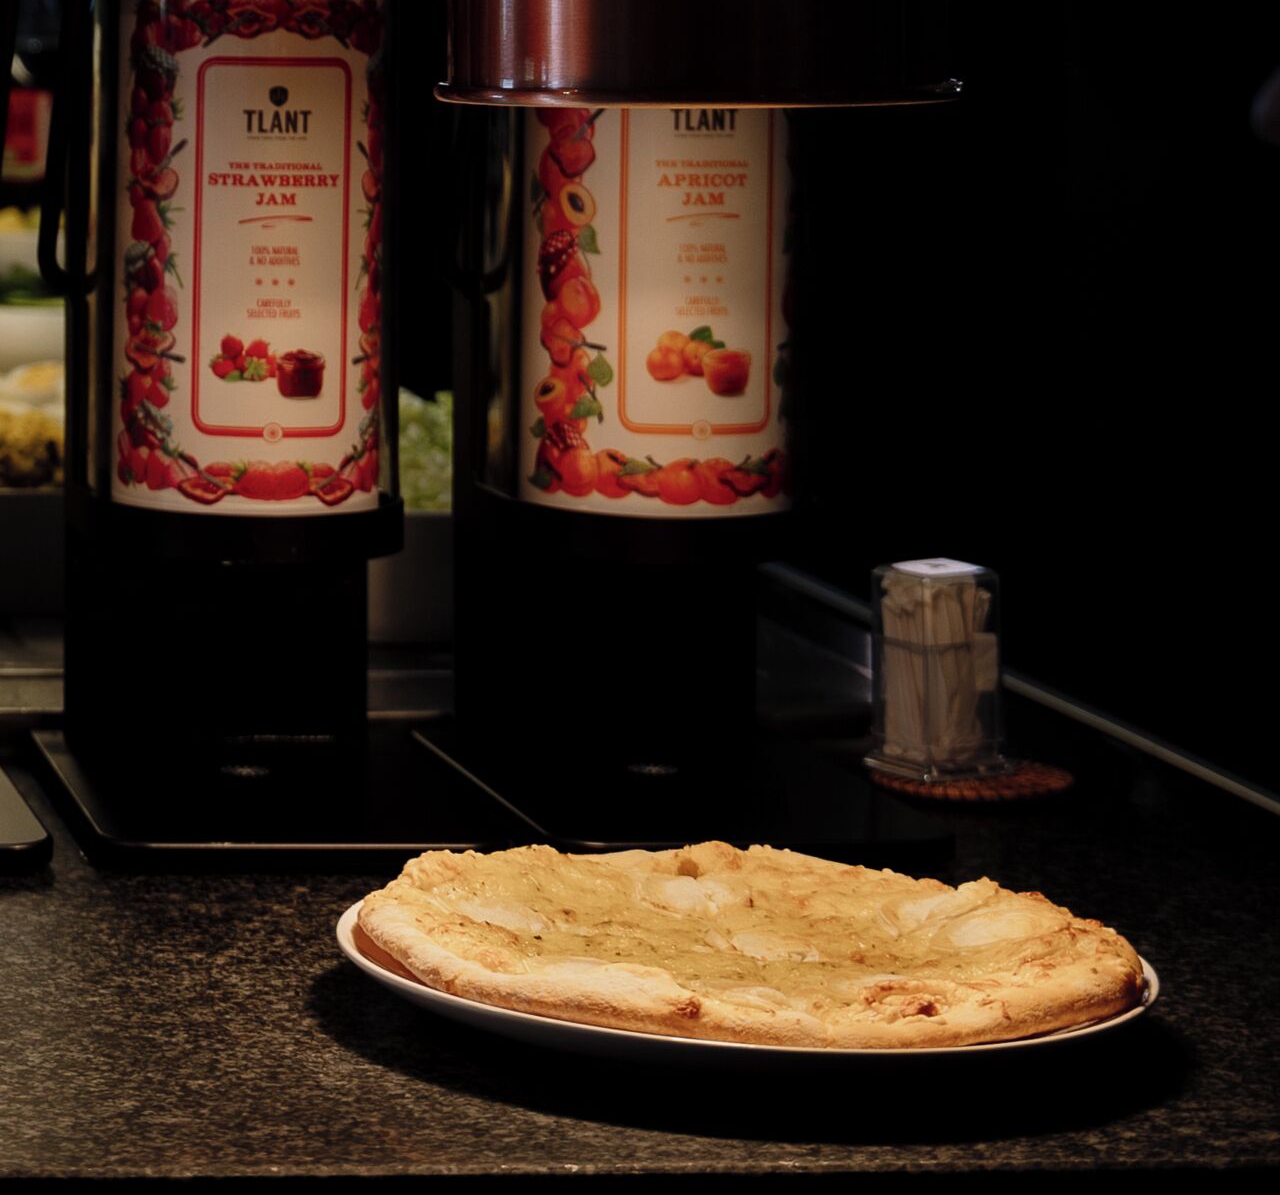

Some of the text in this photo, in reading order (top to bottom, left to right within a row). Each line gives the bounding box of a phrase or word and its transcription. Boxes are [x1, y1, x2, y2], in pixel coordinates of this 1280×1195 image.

[243, 110, 312, 133] TLANT
[671, 108, 739, 131] TLANT
[228, 161, 323, 171] THE TRADITIONAL
[208, 172, 339, 188] STRAWBERRY
[657, 173, 748, 188] APRICOT
[255, 193, 297, 205] JAM
[682, 192, 725, 205] JAM
